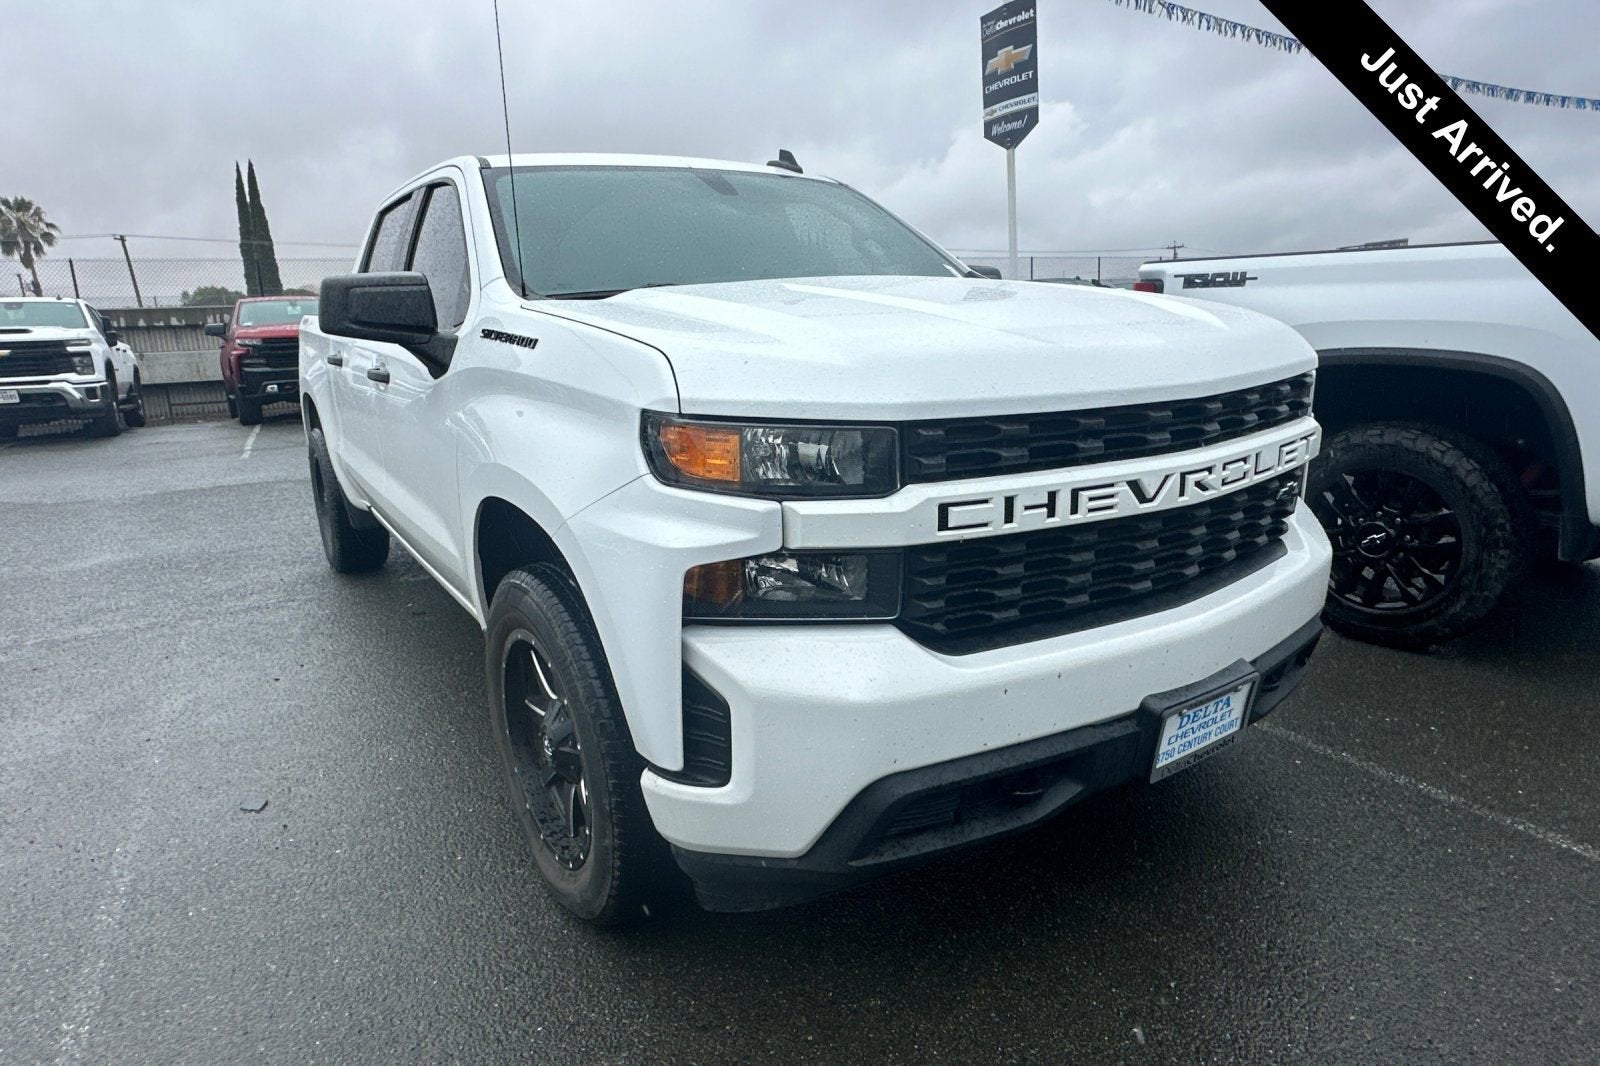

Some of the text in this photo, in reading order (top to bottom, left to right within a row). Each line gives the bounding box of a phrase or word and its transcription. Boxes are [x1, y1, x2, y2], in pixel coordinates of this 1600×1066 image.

[996, 8, 1035, 31] Chevrolet
[985, 70, 1034, 94] CHEVROLET
[998, 96, 1036, 112] CHEVROLET
[991, 114, 1028, 137] Welcome!
[936, 432, 1317, 536] CHEVROLET
[1167, 708, 1234, 746] CHEVROLET
[1177, 695, 1231, 730] DELTA
[1177, 730, 1214, 755] CENTURY
[1214, 717, 1239, 737] COURT
